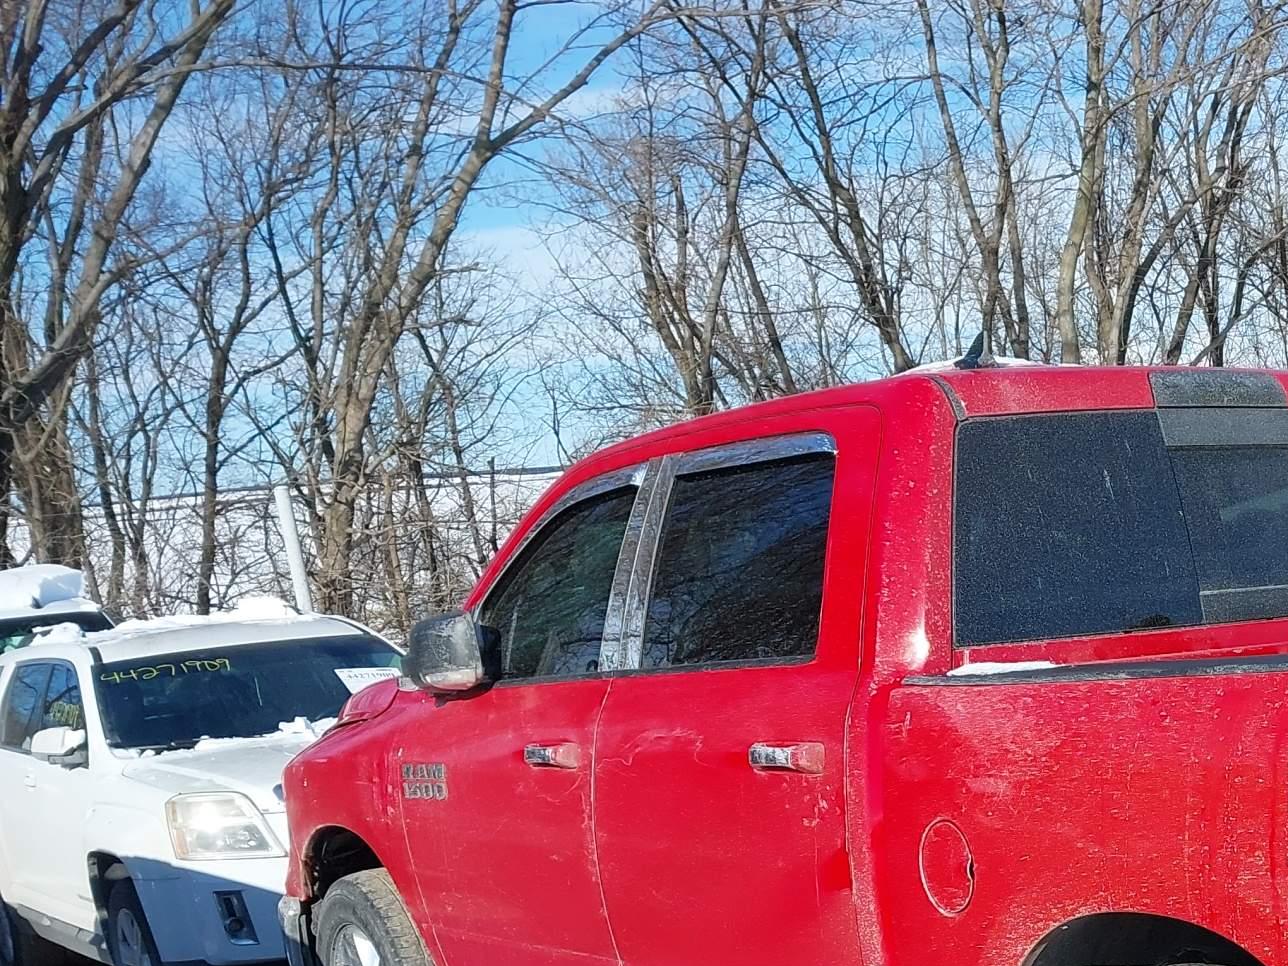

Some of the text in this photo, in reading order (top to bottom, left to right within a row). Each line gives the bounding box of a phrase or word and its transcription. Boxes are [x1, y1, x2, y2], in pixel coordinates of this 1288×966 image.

[100, 658, 231, 684] 44271909
[402, 763, 446, 780] RAM
[402, 783, 448, 800] 1500
